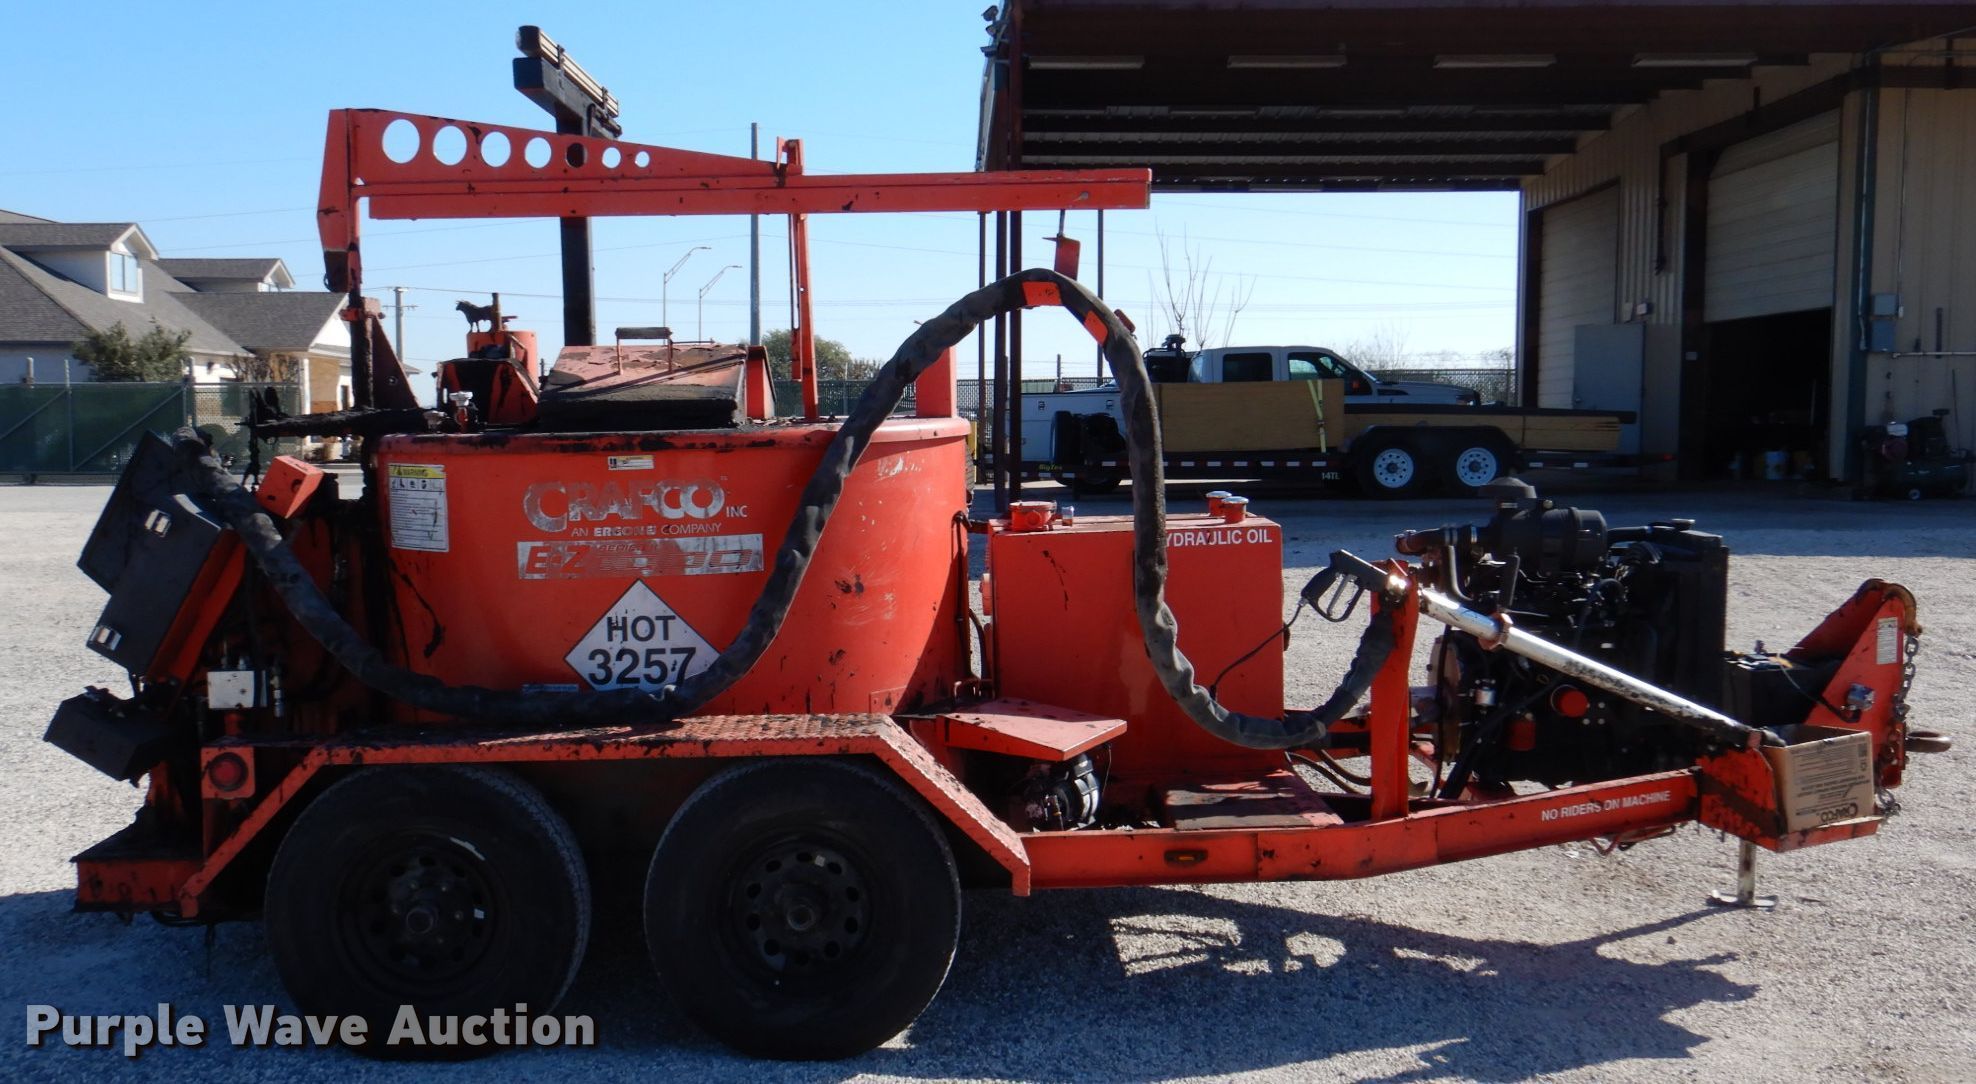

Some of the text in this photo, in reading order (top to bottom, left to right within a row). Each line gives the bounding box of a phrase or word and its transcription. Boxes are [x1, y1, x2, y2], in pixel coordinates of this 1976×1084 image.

[523, 479, 749, 533] CRAFCO INC
[571, 527, 589, 537] AN
[661, 522, 722, 535] COMPANY
[1166, 528, 1273, 547] YDRAULIC OIL
[606, 615, 677, 642] HOT
[587, 646, 697, 687] 3257
[1541, 790, 1672, 821] NO RIDERS ON MACHINE
